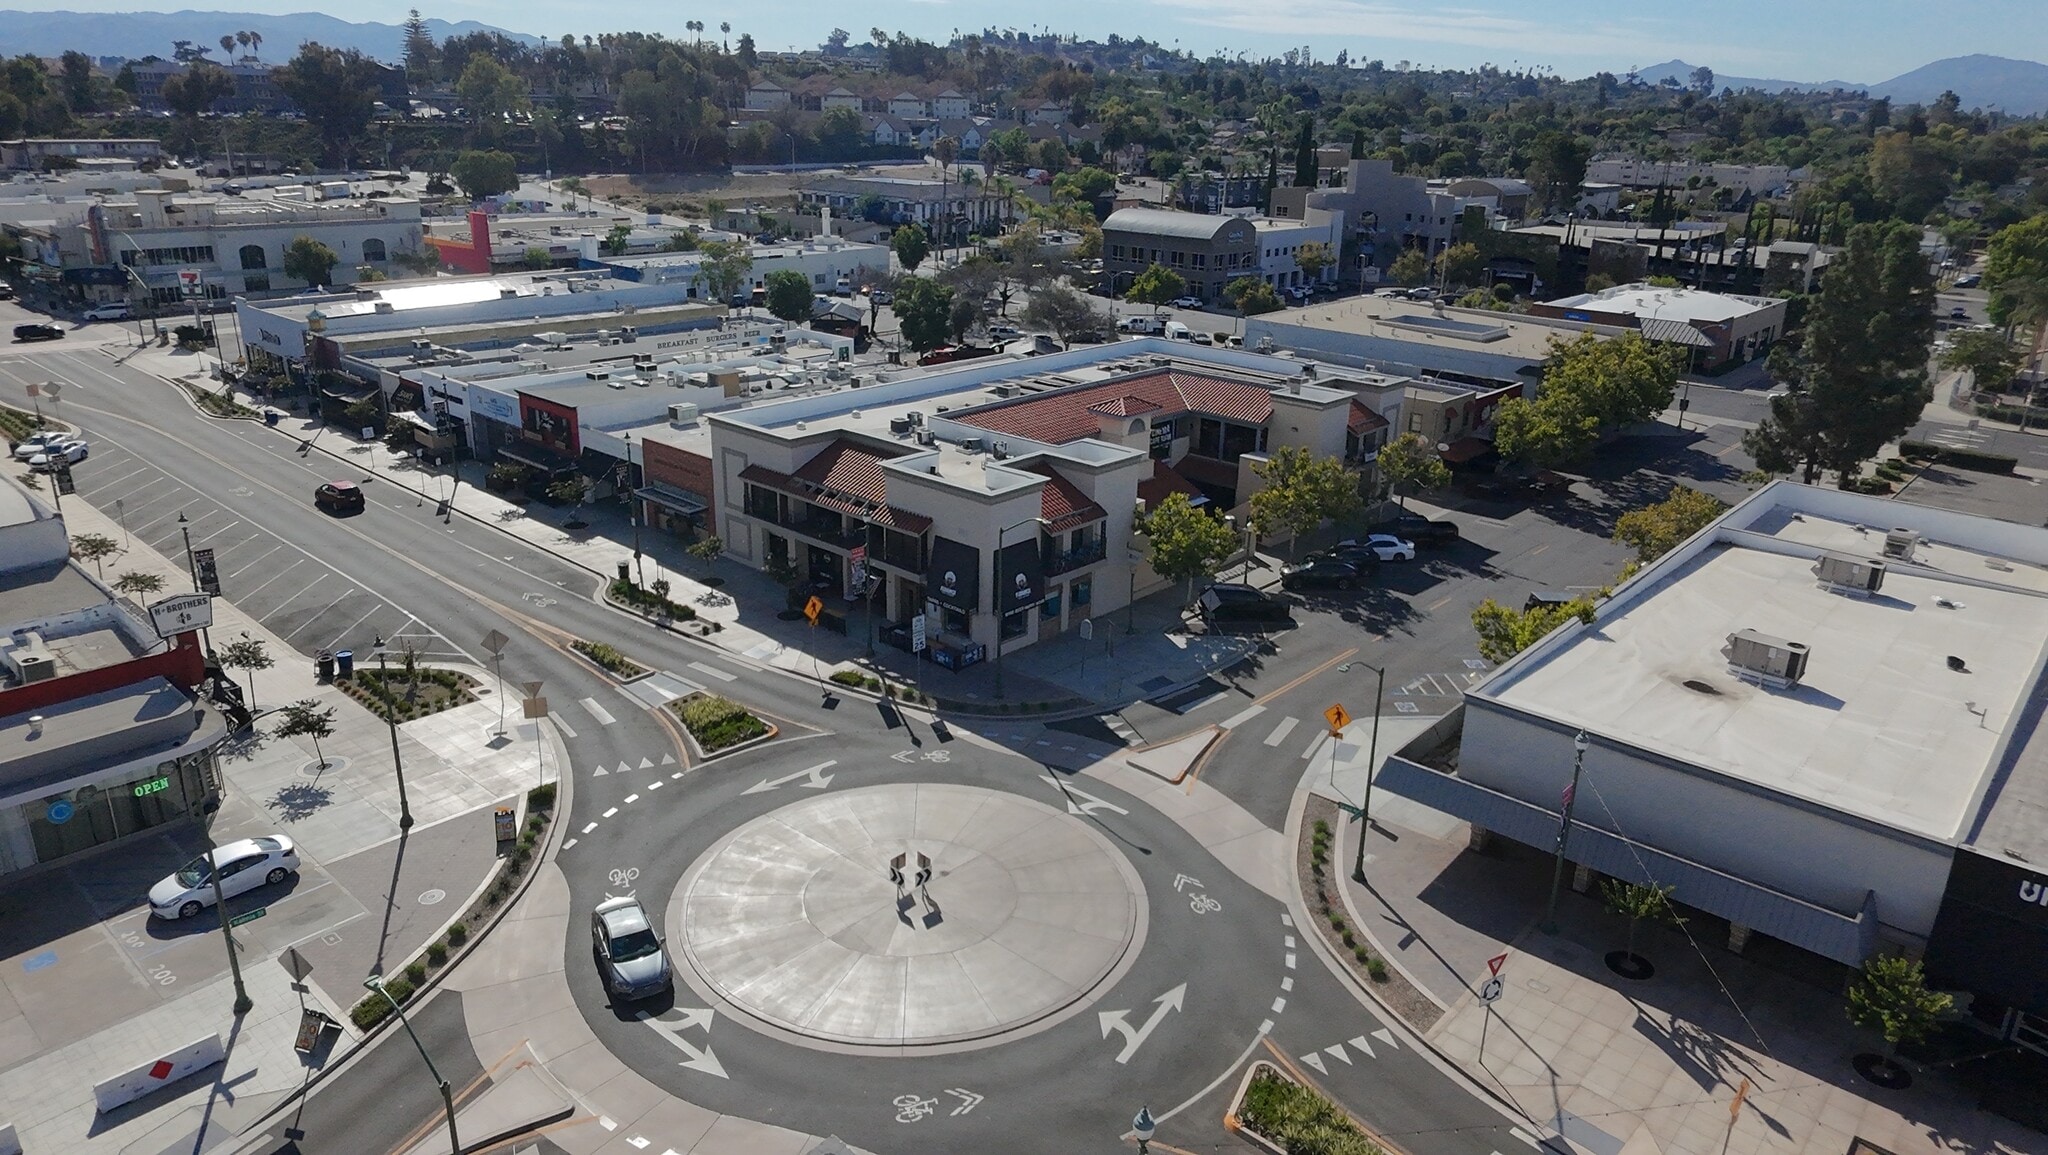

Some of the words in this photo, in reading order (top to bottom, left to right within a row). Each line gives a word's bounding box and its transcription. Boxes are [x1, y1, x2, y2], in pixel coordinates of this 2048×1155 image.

[657, 338, 699, 349] BREAKFAST
[706, 333, 737, 343] BURGERS
[914, 641, 925, 650] 25
[134, 777, 169, 797] OPEN
[147, 963, 177, 986] 200
